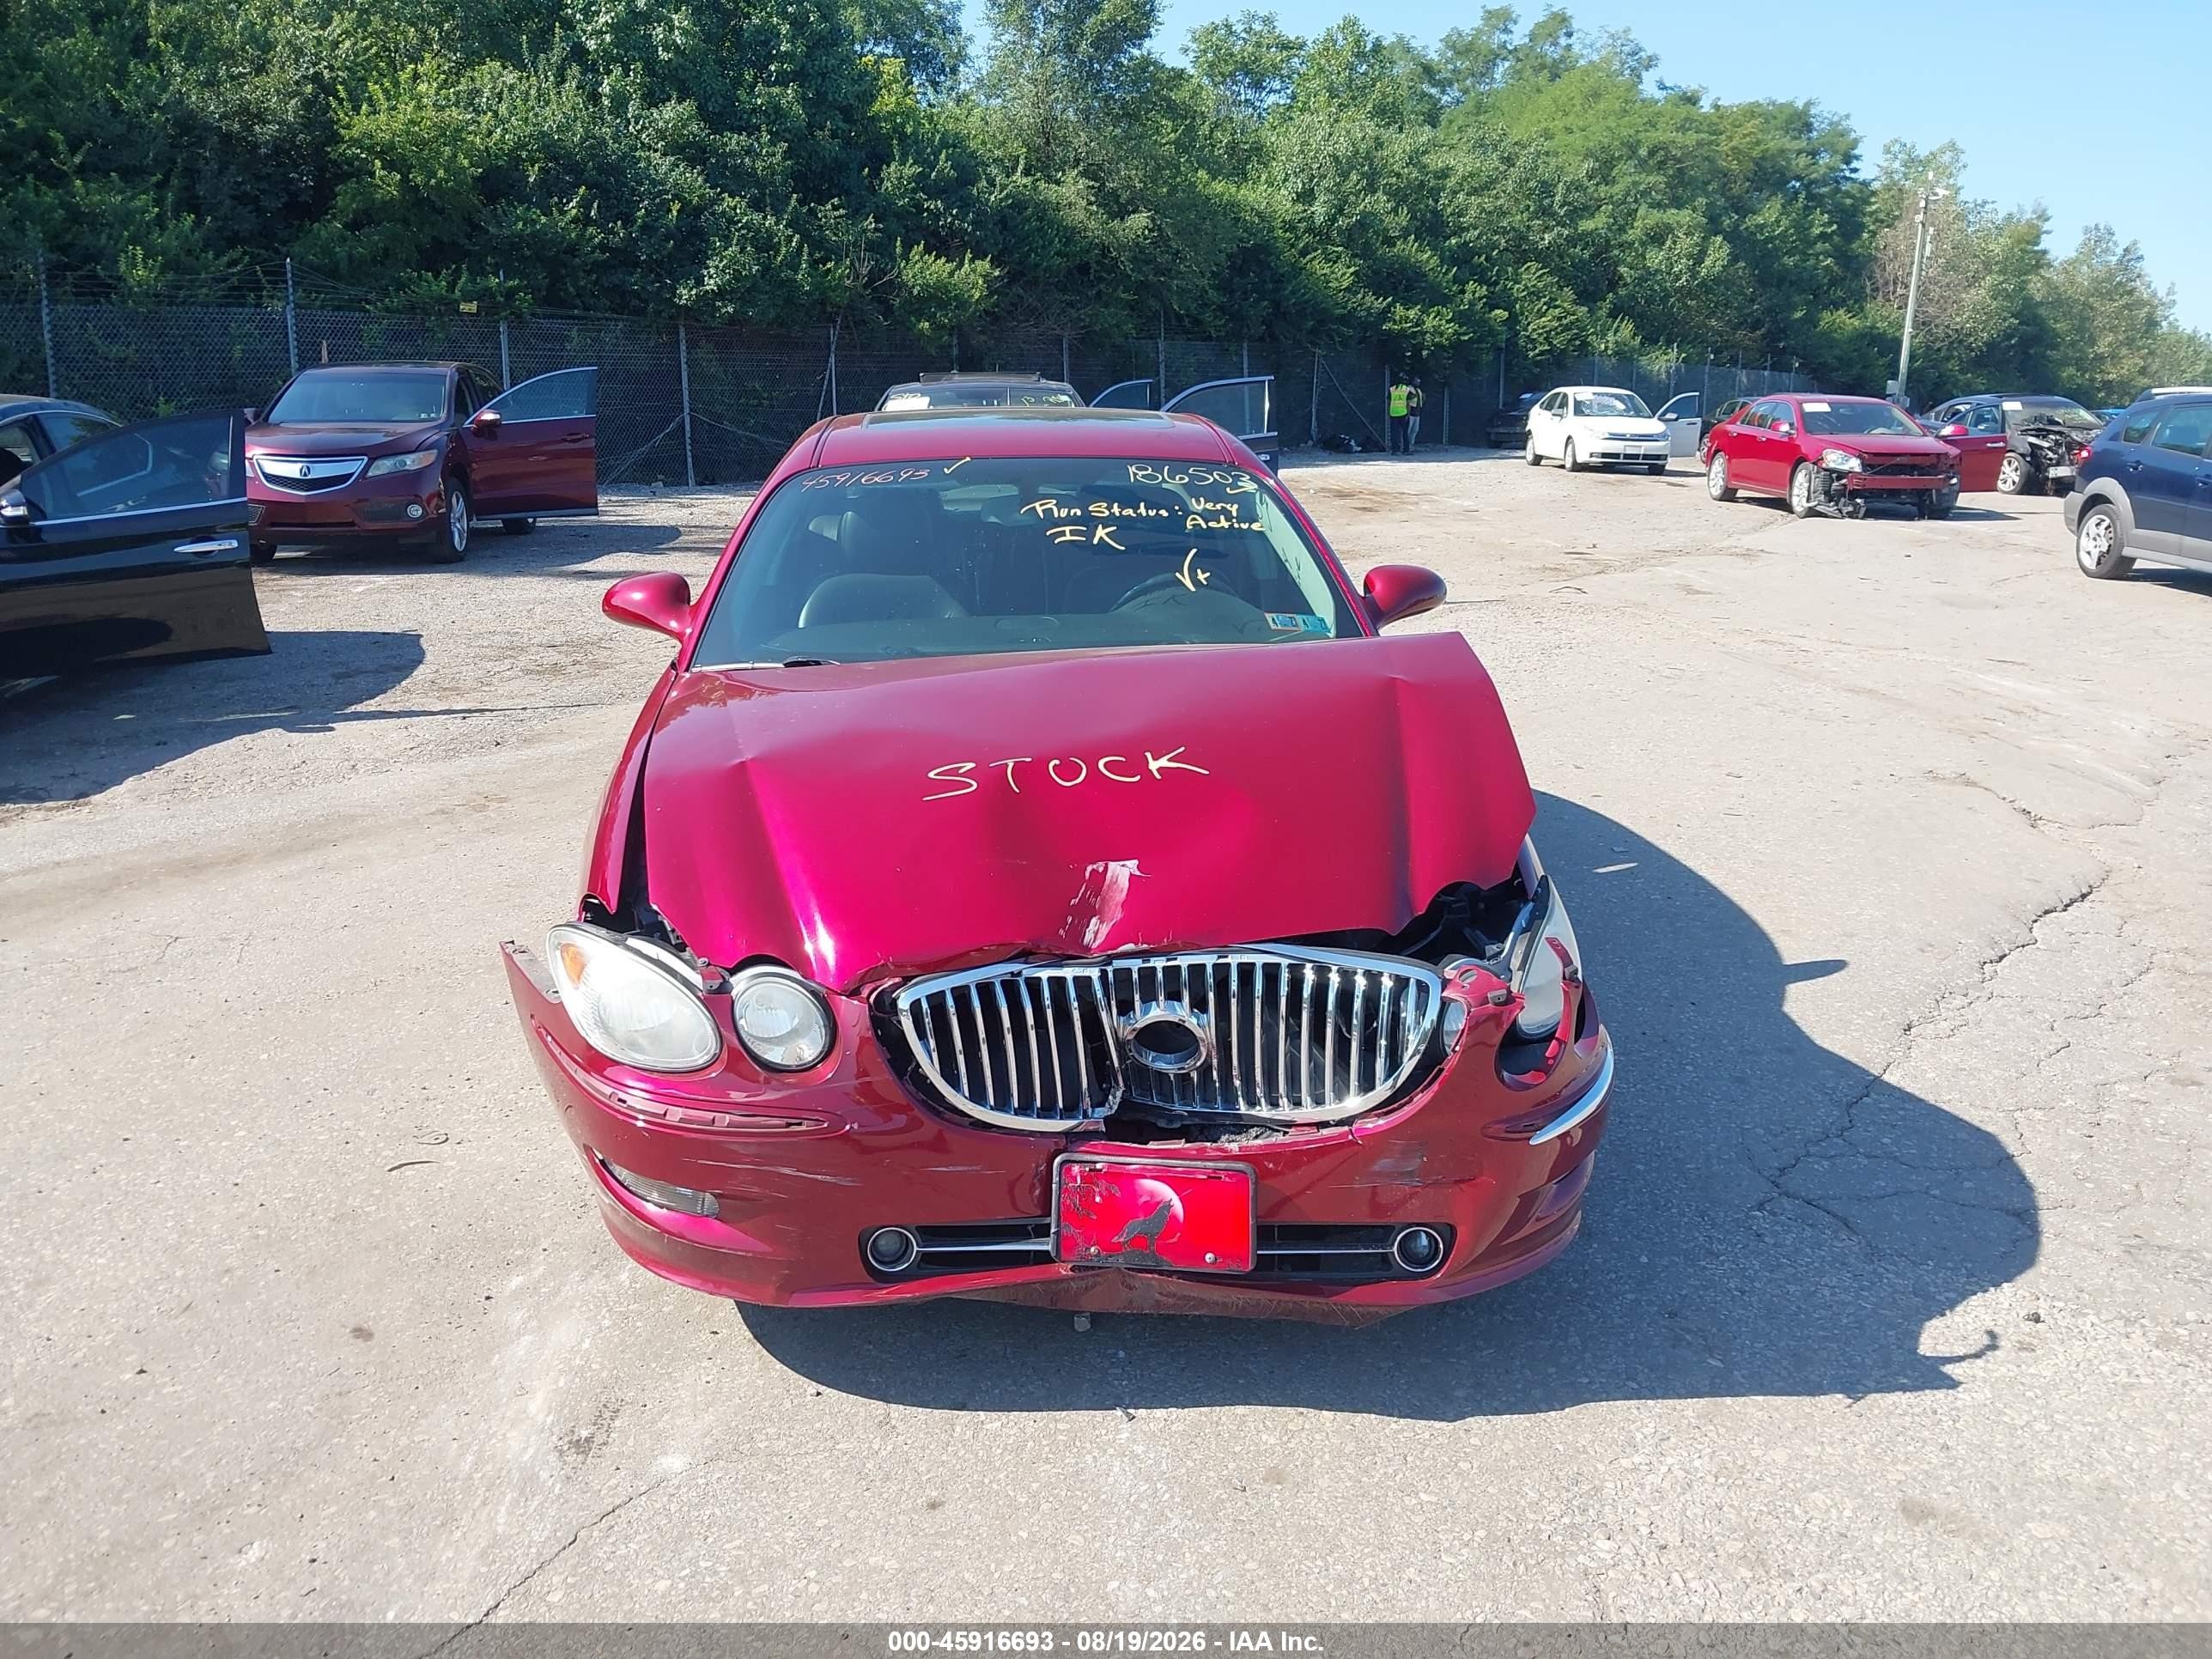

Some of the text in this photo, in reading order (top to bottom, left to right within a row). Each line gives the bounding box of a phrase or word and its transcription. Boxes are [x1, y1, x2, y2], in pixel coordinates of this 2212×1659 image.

[1127, 464, 1251, 485] 186503
[1020, 499, 1082, 520] Run
[1192, 496, 1239, 517] Very
[1186, 514, 1266, 532] Active
[921, 746, 1210, 801] STOCK
